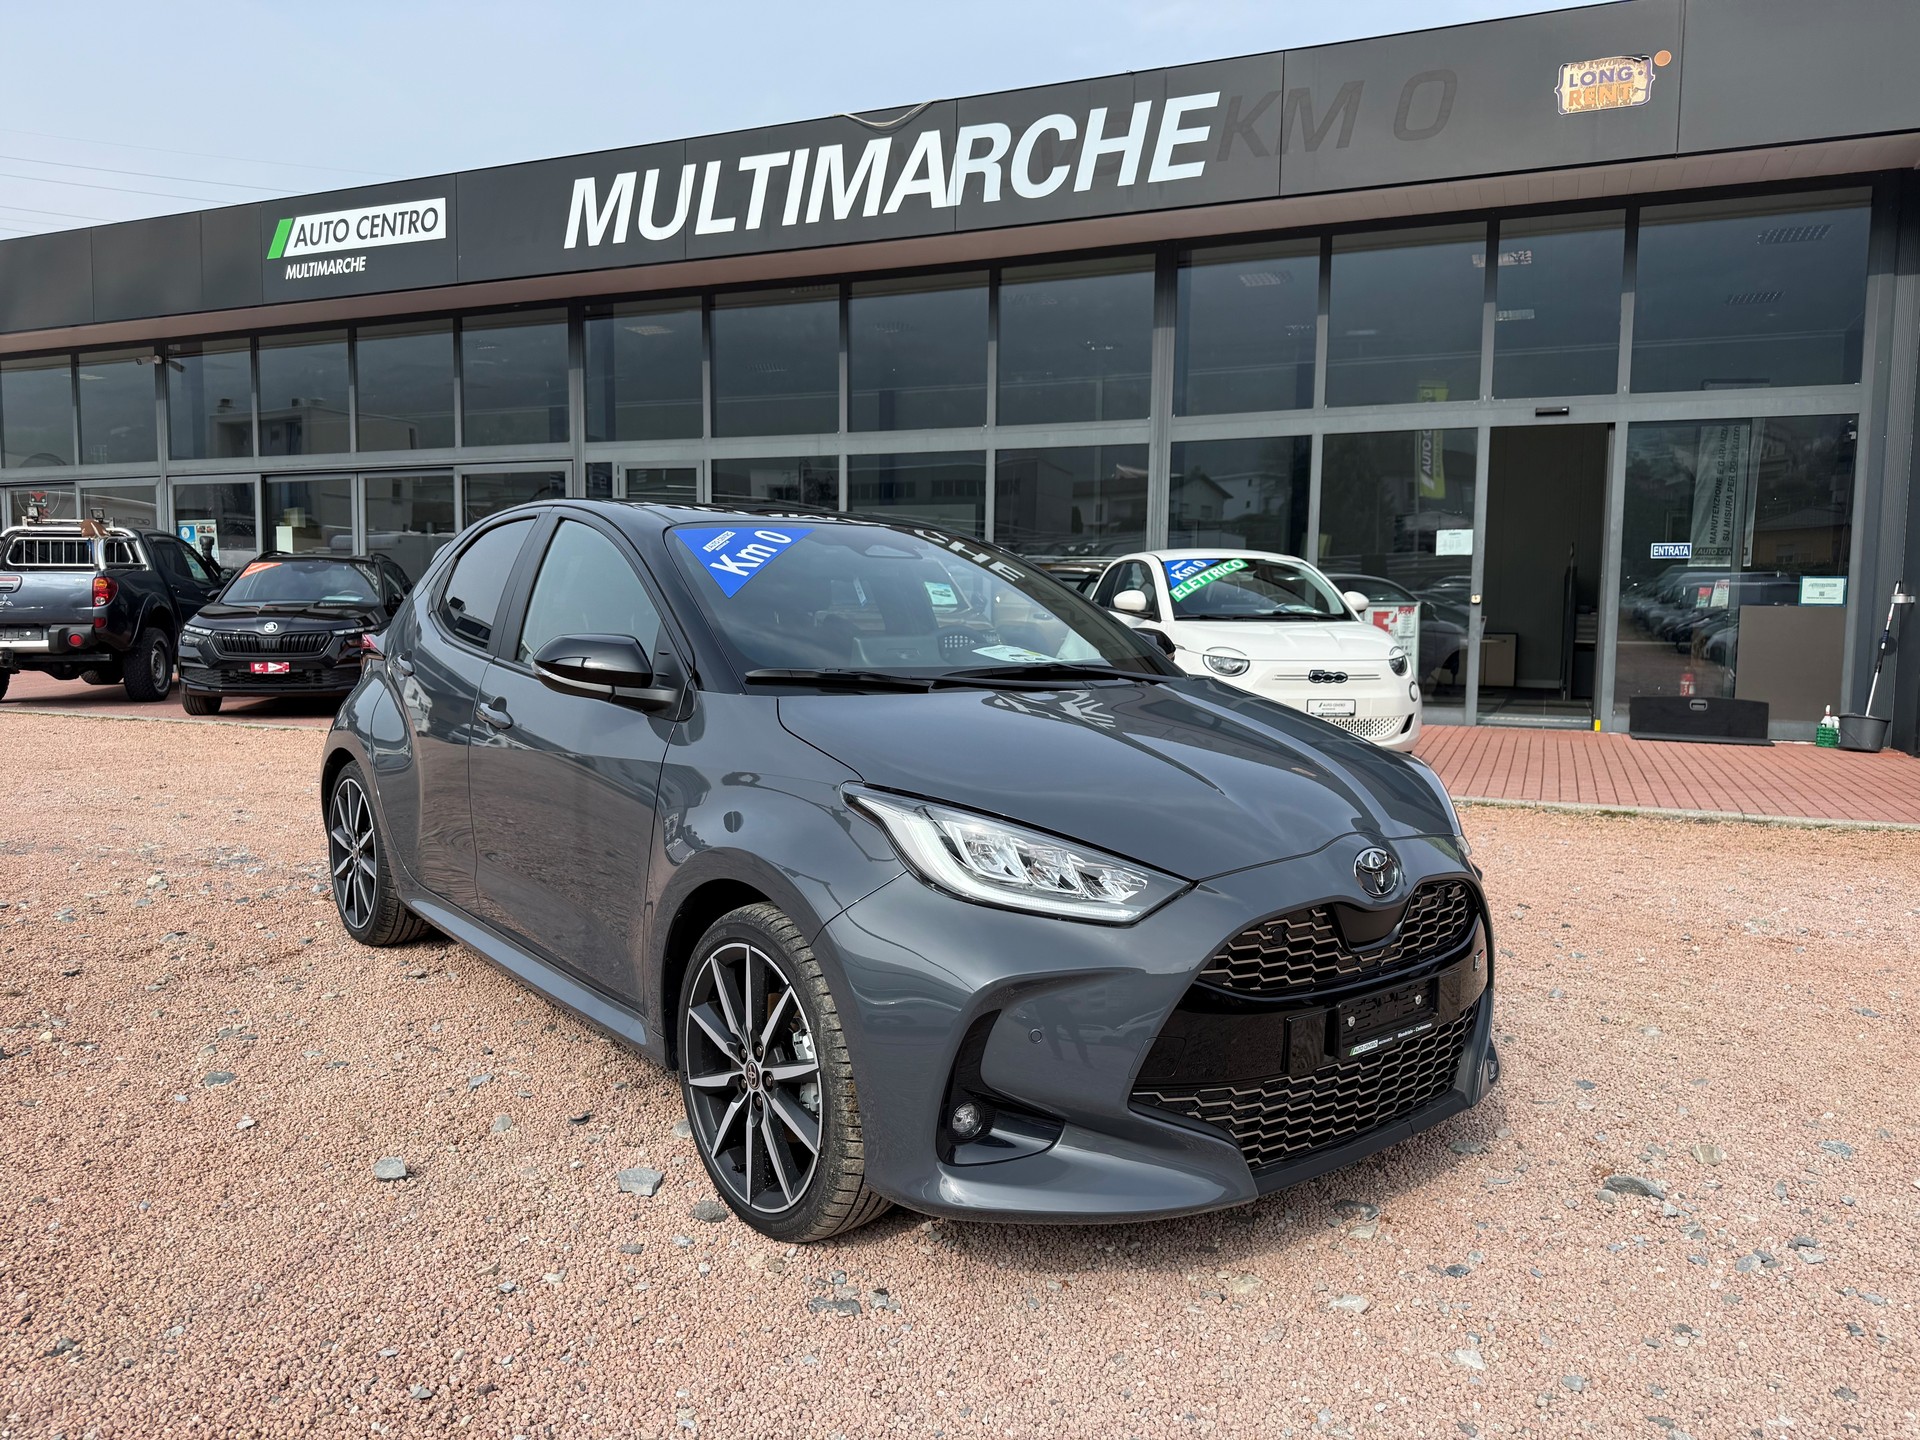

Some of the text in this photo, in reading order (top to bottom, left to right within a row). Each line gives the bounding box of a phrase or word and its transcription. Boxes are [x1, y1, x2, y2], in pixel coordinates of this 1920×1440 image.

[1569, 66, 1634, 88] LONG
[1568, 83, 1634, 107] RENT
[1215, 80, 1366, 163] KM
[563, 91, 1220, 250] MULTIMARCHE
[294, 207, 439, 248] AUTO CENTRO
[285, 256, 367, 280] MULTIMARCHE
[1421, 439, 1432, 475] AUTO
[1727, 475, 1736, 493] PER
[1709, 477, 1723, 545] MANUTENZIONE
[1724, 494, 1734, 528] MISURA
[1723, 529, 1731, 542] SU
[709, 543, 778, 577] Km
[1653, 545, 1689, 556] ENTRATA
[1697, 547, 1718, 555] AUTO
[1171, 566, 1199, 581] Km
[1173, 559, 1244, 598] ELETTRICO
[1308, 669, 1349, 684] 500
